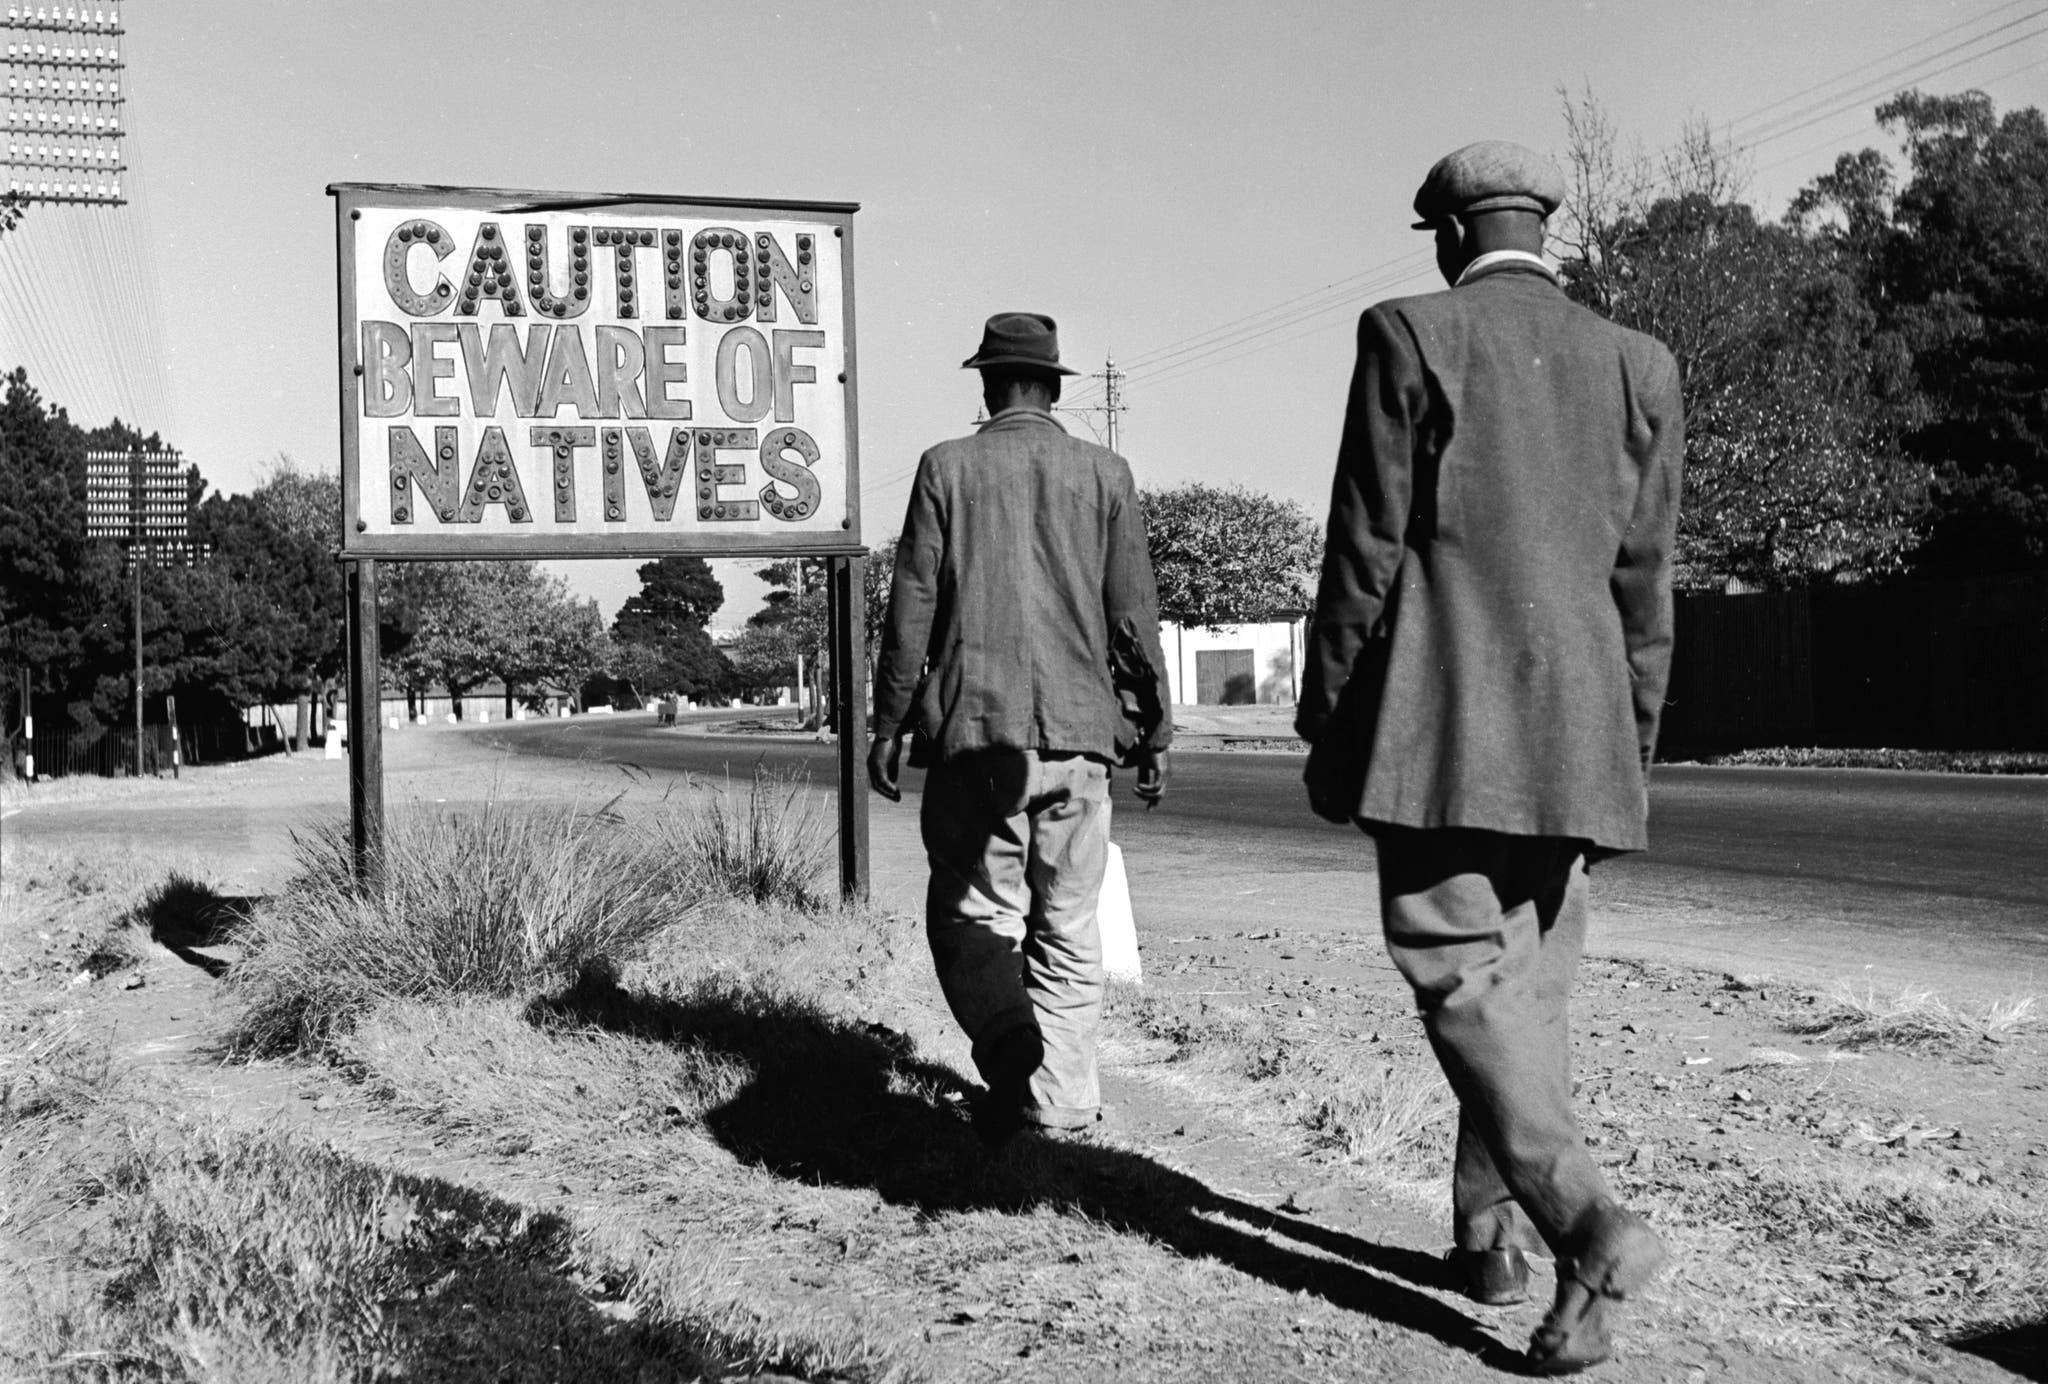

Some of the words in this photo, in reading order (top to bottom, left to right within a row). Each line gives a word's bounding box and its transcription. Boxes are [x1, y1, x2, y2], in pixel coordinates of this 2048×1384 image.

[383, 218, 818, 324] CAUTION
[361, 320, 692, 420] BEWARE
[715, 325, 825, 423] OF
[388, 426, 821, 524] NATIVES
